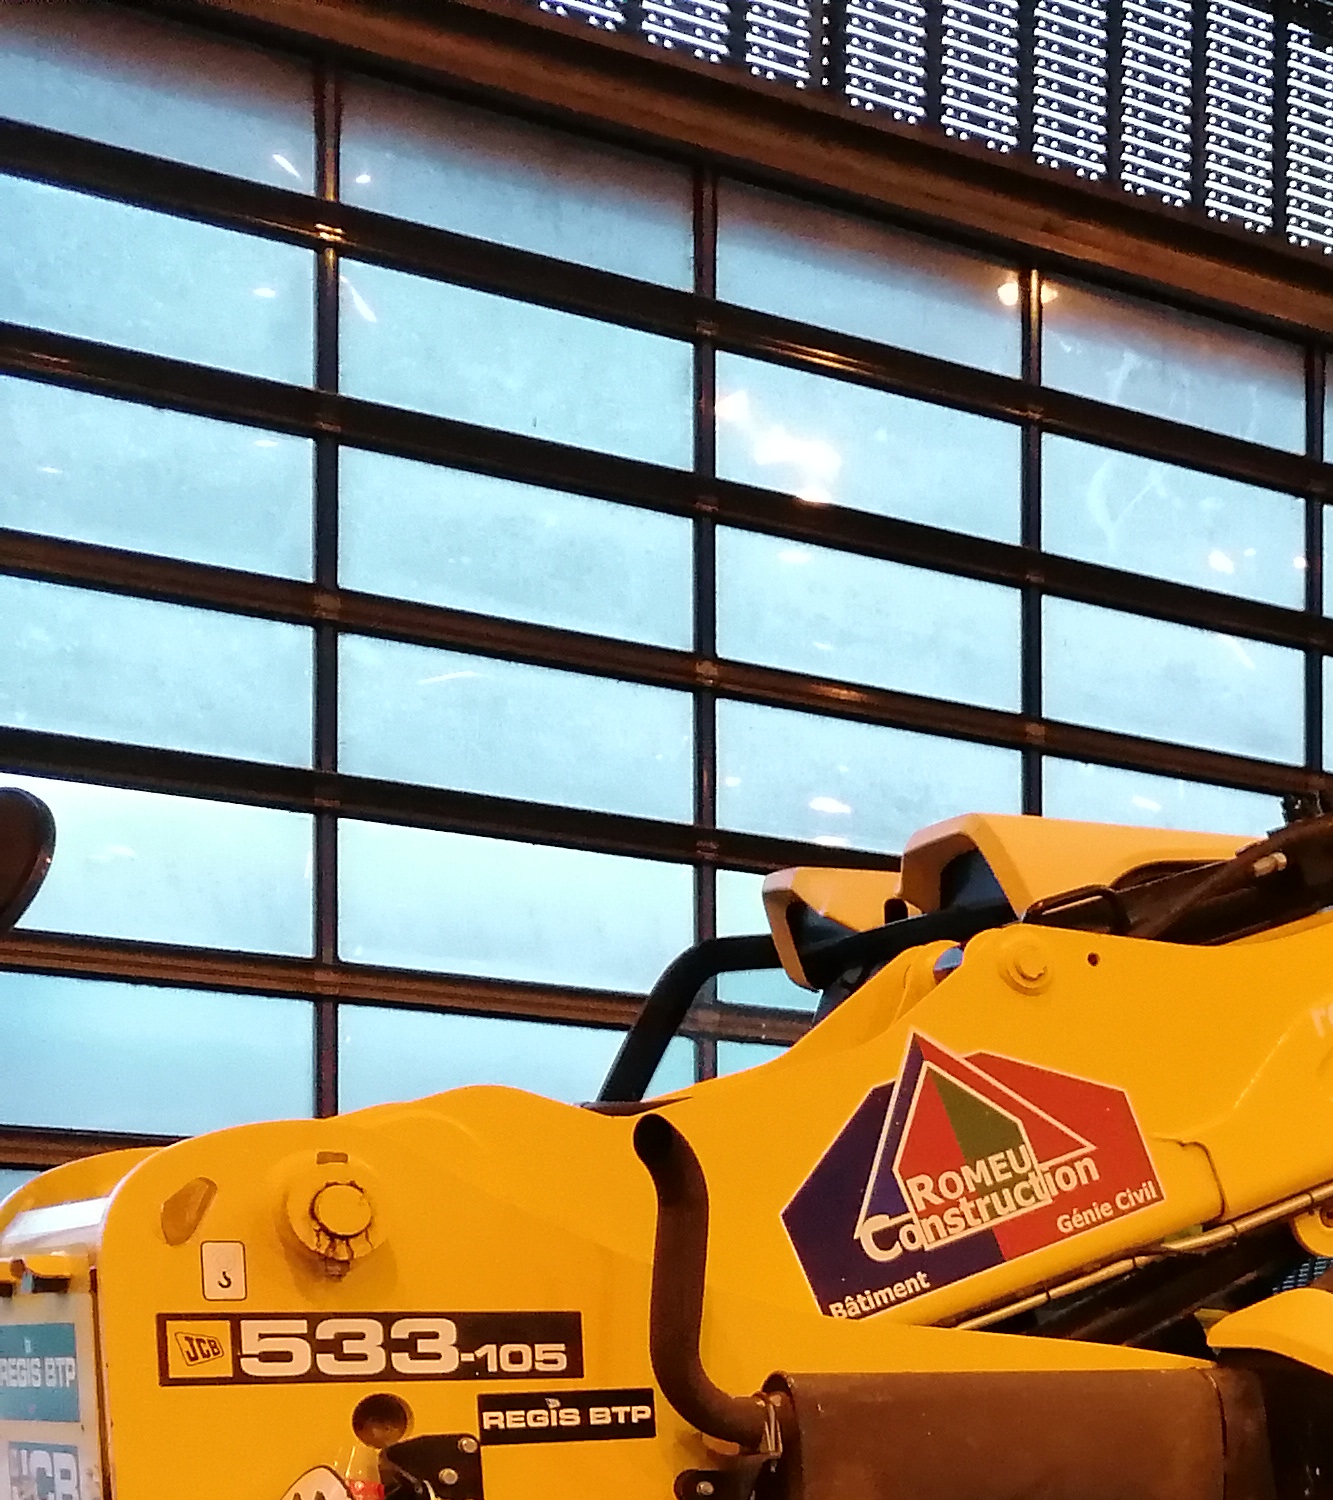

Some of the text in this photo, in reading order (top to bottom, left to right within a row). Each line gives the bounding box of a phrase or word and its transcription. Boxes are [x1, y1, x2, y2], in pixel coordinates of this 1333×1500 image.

[859, 1155, 1100, 1262] Construction
[1056, 1180, 1160, 1235] Génie Civil
[828, 1270, 931, 1319] Bâtiment
[183, 1335, 225, 1363] JCB
[45, 1357, 76, 1388] BTP
[588, 1405, 652, 1425] BTP
